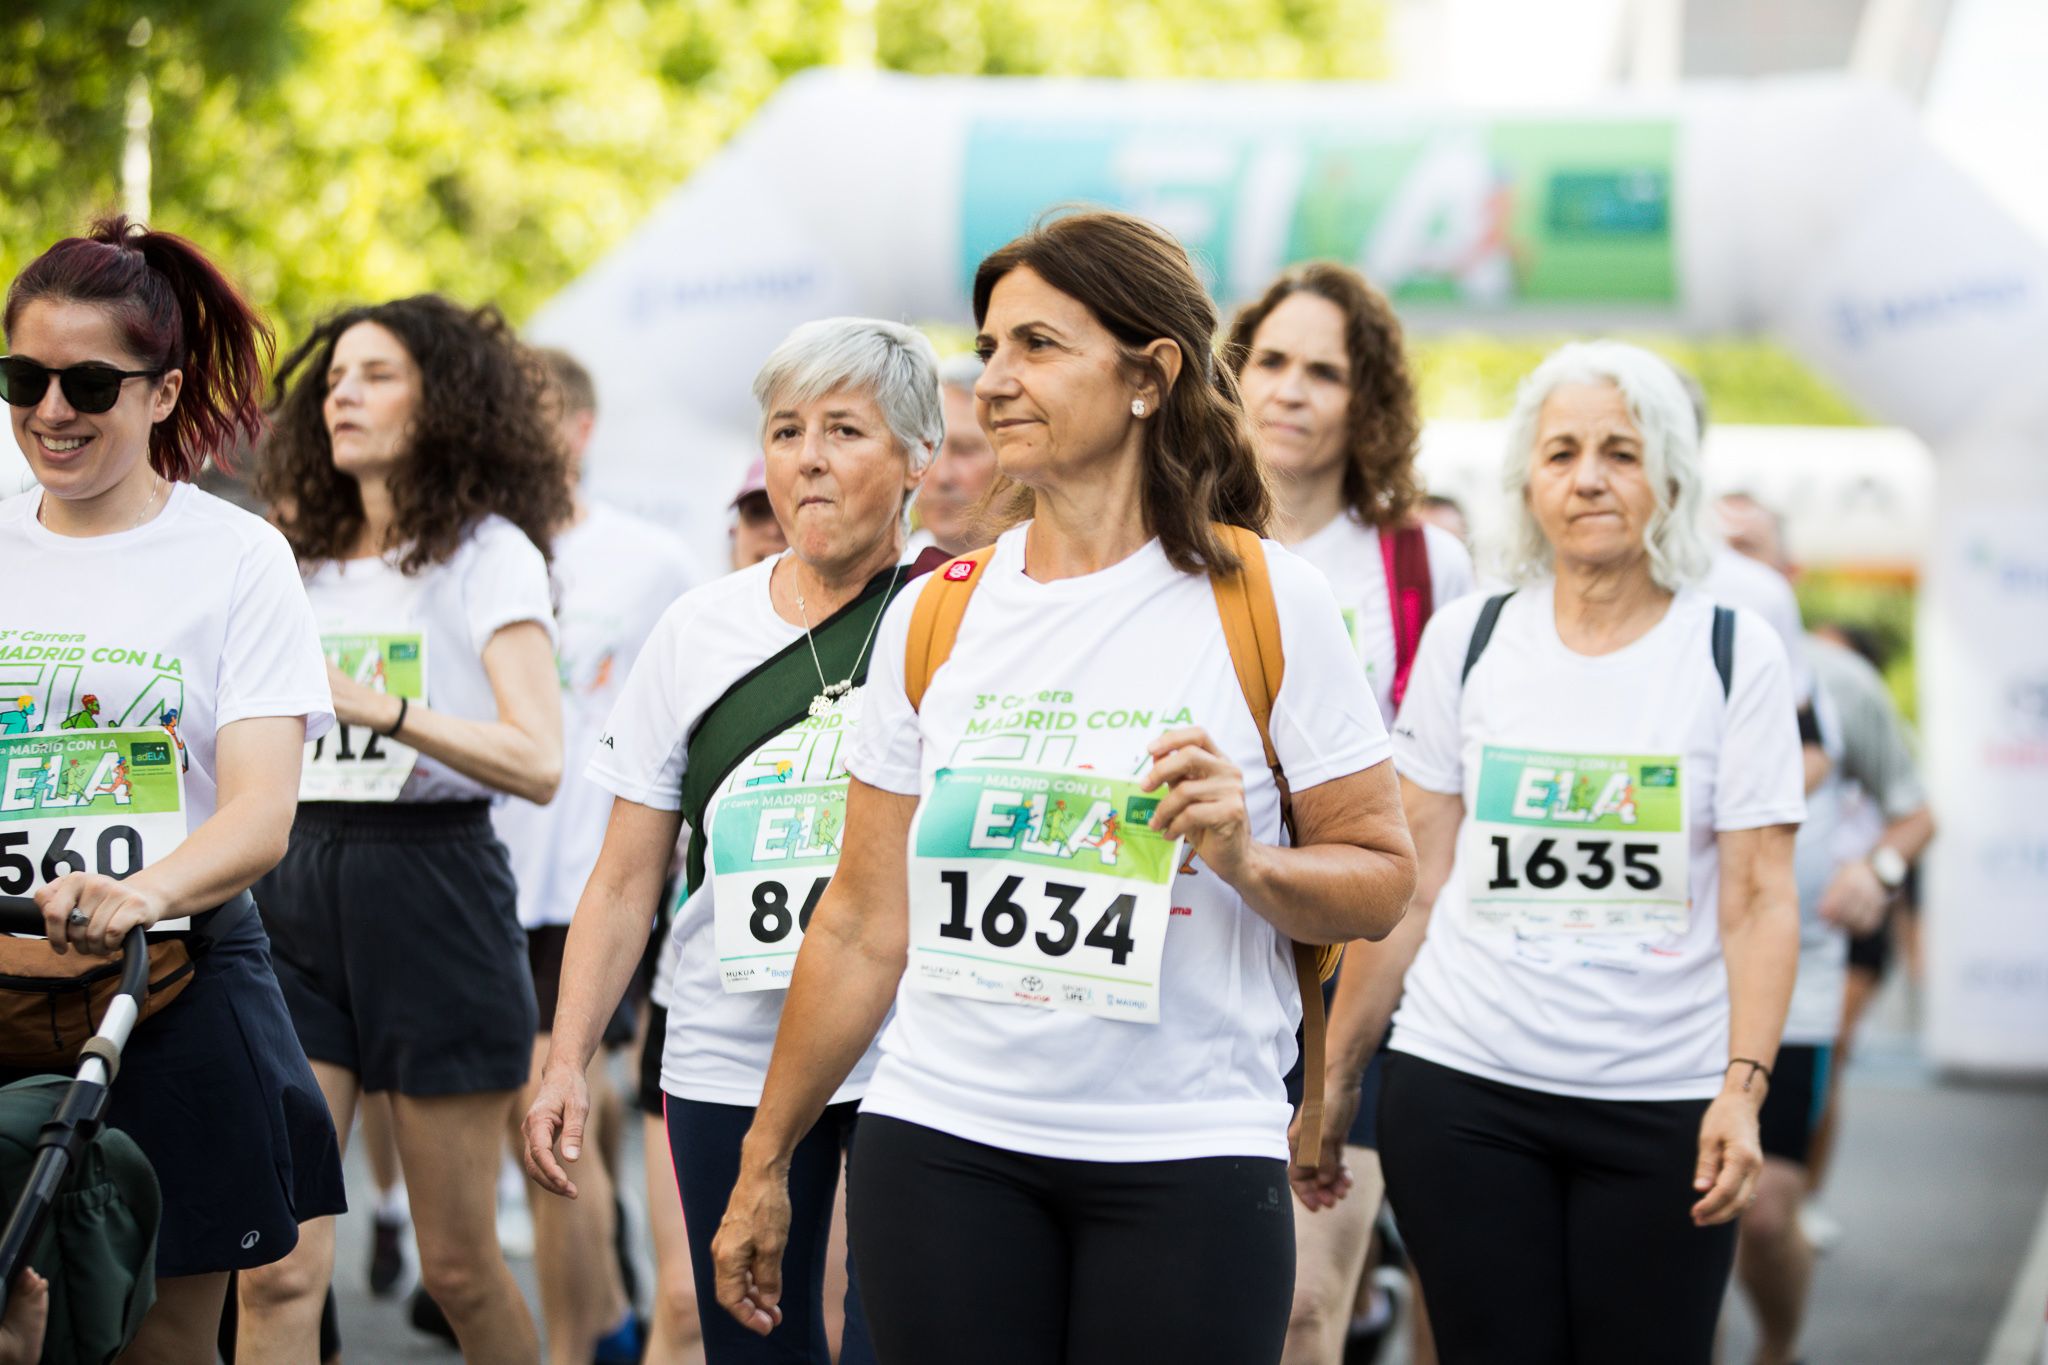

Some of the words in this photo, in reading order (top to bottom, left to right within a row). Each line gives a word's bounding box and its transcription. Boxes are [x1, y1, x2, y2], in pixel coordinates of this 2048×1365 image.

[20, 630, 87, 643] Carrera
[91, 648, 148, 668] CON
[152, 653, 182, 675] LA
[1001, 689, 1074, 710] Caera
[965, 709, 1078, 735] MADRID
[1086, 710, 1154, 731] CON
[1160, 706, 1194, 725] LA
[9, 742, 64, 756] MADRID
[67, 740, 97, 752] CON
[99, 739, 118, 751] LA
[313, 720, 386, 762] 12
[0, 751, 132, 812] ELA
[985, 774, 1050, 792] MADRID
[1053, 779, 1088, 796] CON
[1090, 785, 1113, 799] LA
[1511, 766, 1638, 825] ELA
[762, 792, 818, 807] MADRID
[969, 788, 1121, 866] ELA
[0, 824, 144, 896] 560
[1488, 835, 1663, 891] 1635
[940, 870, 1138, 966] 1634
[726, 968, 756, 978] MUKUA
[771, 968, 793, 979] Bioge
